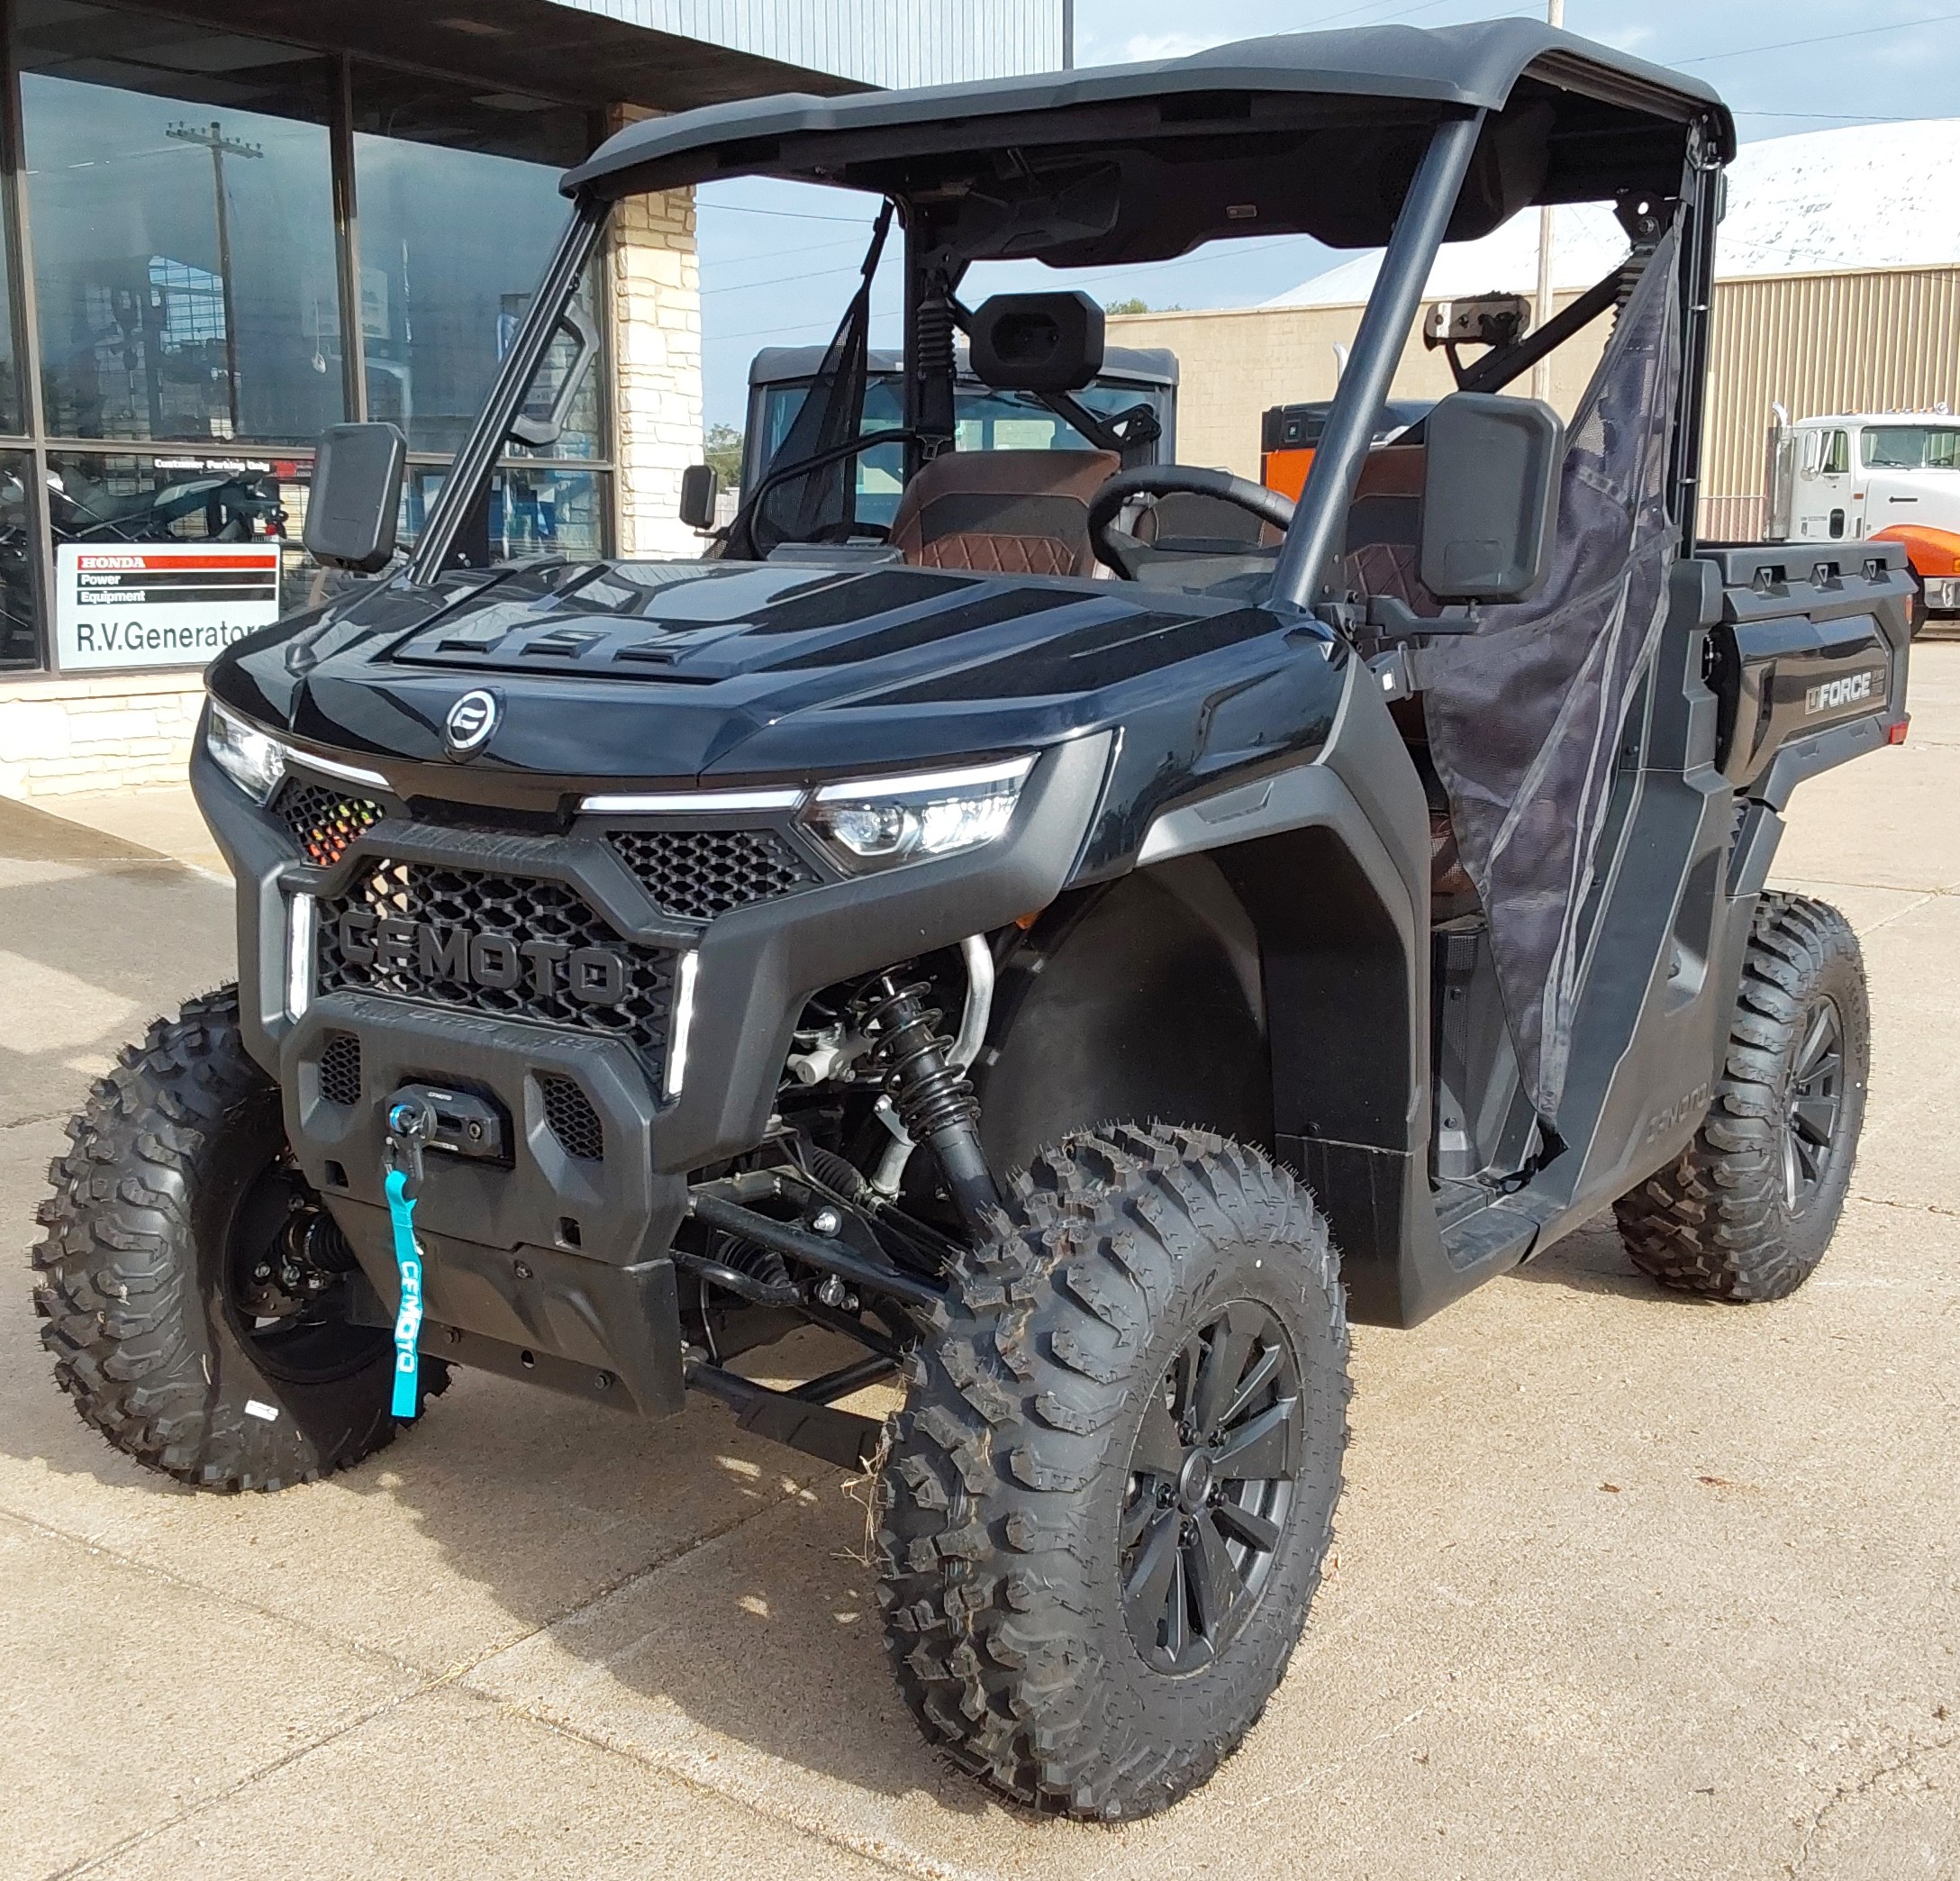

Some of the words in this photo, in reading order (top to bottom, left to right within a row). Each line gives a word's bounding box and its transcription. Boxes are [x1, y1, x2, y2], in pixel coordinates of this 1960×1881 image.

[154, 459, 204, 468] Customer
[81, 557, 146, 568] HONDA
[81, 575, 121, 585] Power
[81, 591, 145, 604] Equipment
[339, 910, 625, 1004] CFMOTO
[396, 1260, 422, 1373] CFMOTO
